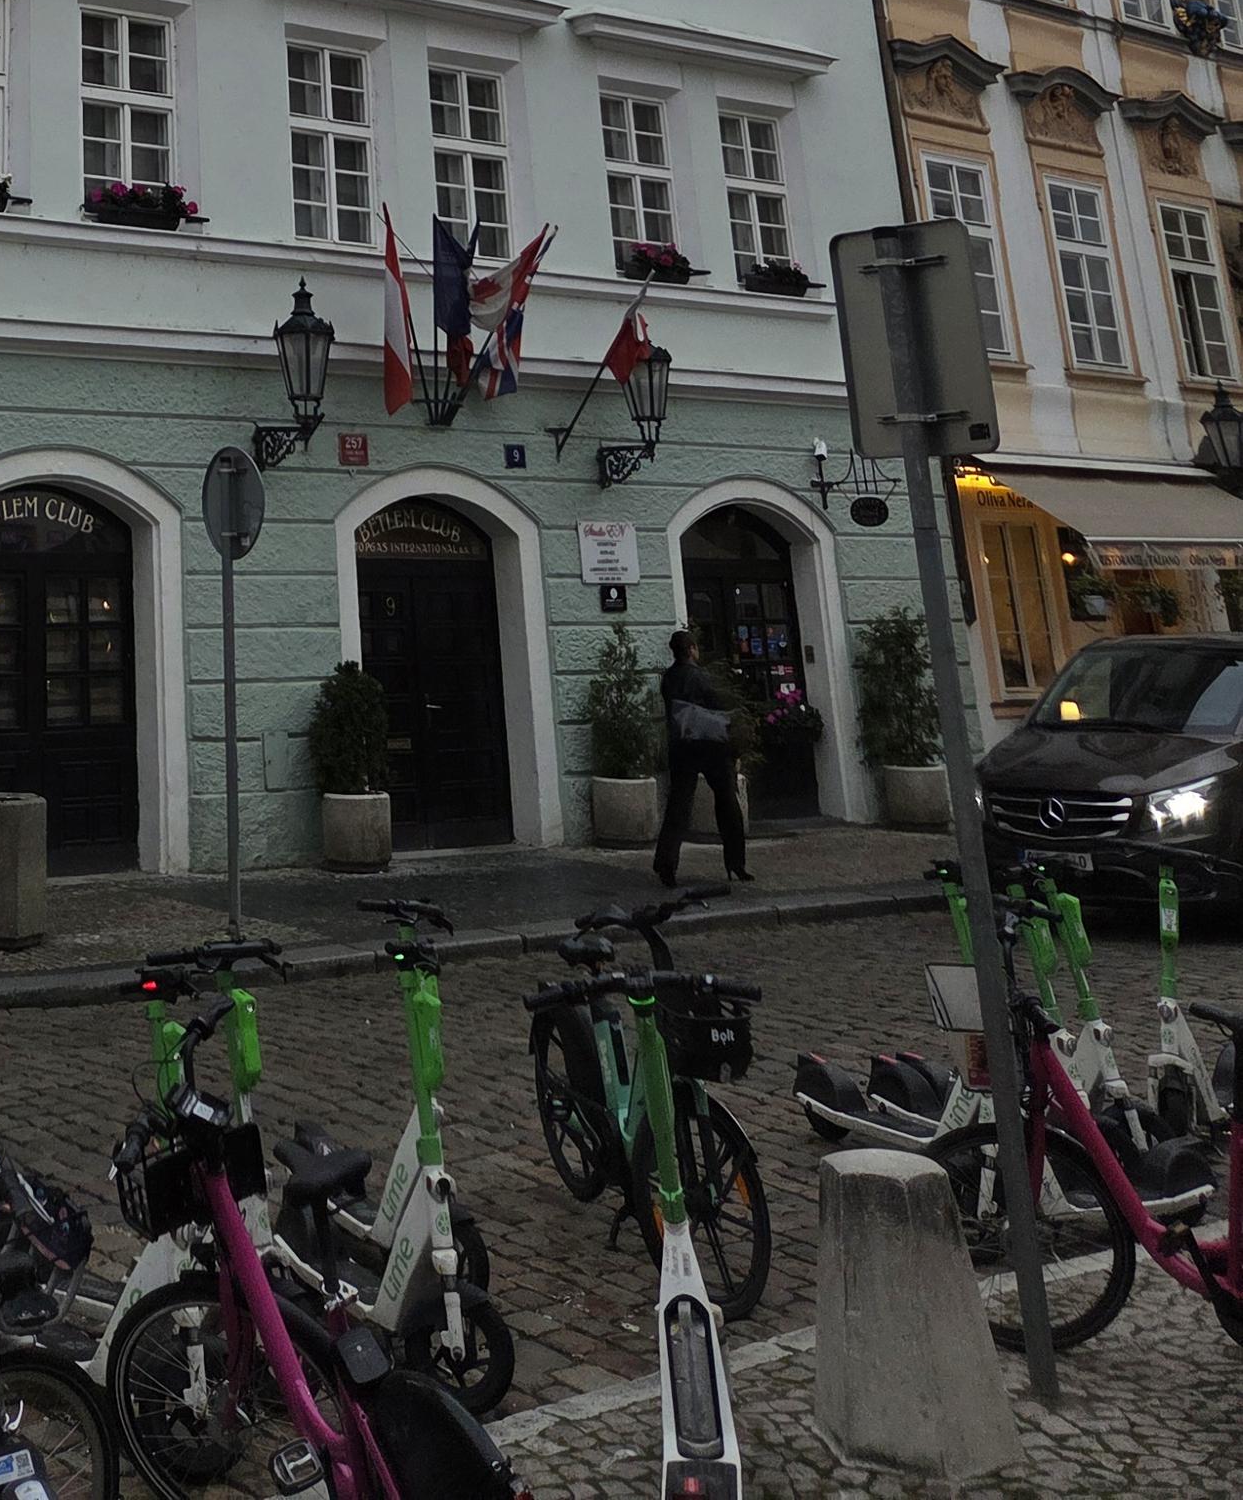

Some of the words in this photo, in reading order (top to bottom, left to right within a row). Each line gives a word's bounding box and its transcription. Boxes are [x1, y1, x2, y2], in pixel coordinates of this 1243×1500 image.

[345, 436, 362, 449] 257
[513, 449, 520, 462] 9
[977, 490, 1006, 507] Oliva
[45, 498, 95, 533] CLUB
[358, 508, 416, 542] BETLEM
[420, 511, 461, 542] CLUB
[385, 596, 396, 617] 9
[710, 1027, 736, 1046] Bolt
[382, 1163, 408, 1223] Lime
[384, 1237, 414, 1301] Lime
